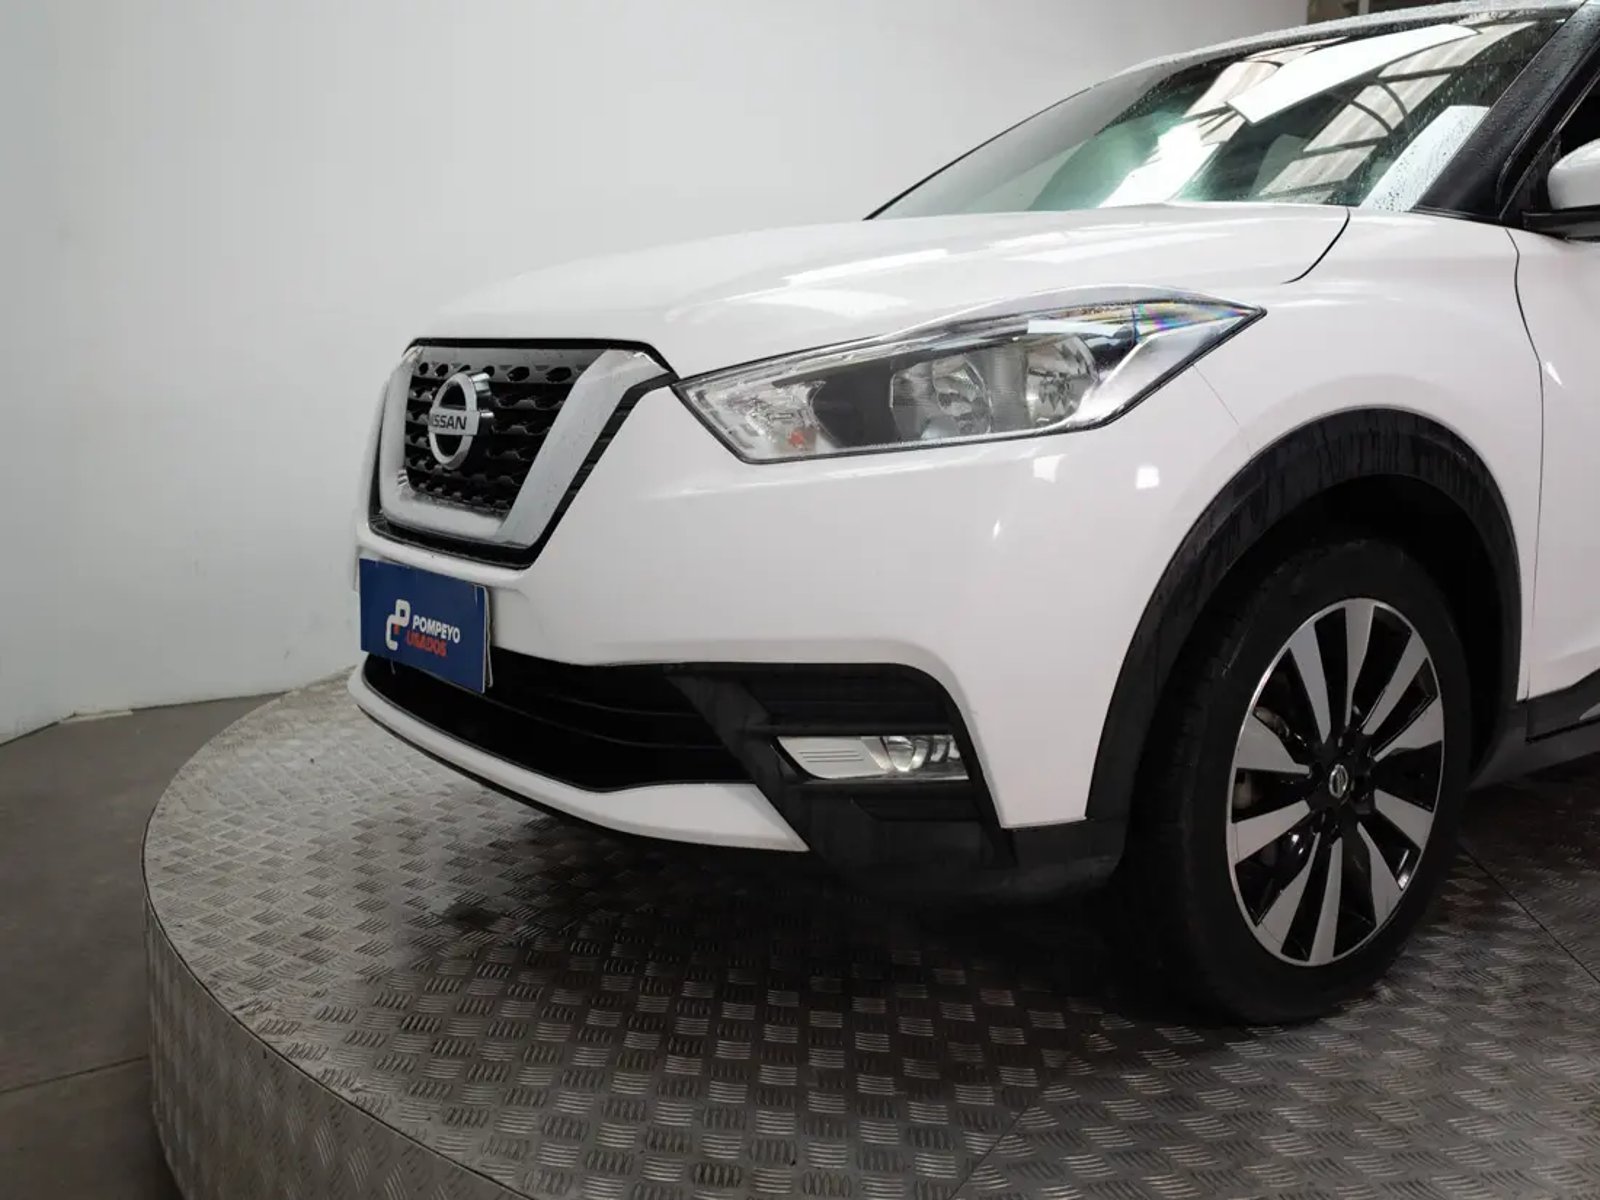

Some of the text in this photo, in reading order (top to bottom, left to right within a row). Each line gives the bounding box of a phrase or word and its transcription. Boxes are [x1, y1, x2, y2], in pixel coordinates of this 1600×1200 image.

[430, 413, 467, 430] SSAN
[406, 629, 447, 657] USADOS
[412, 614, 461, 644] POMPEYO
